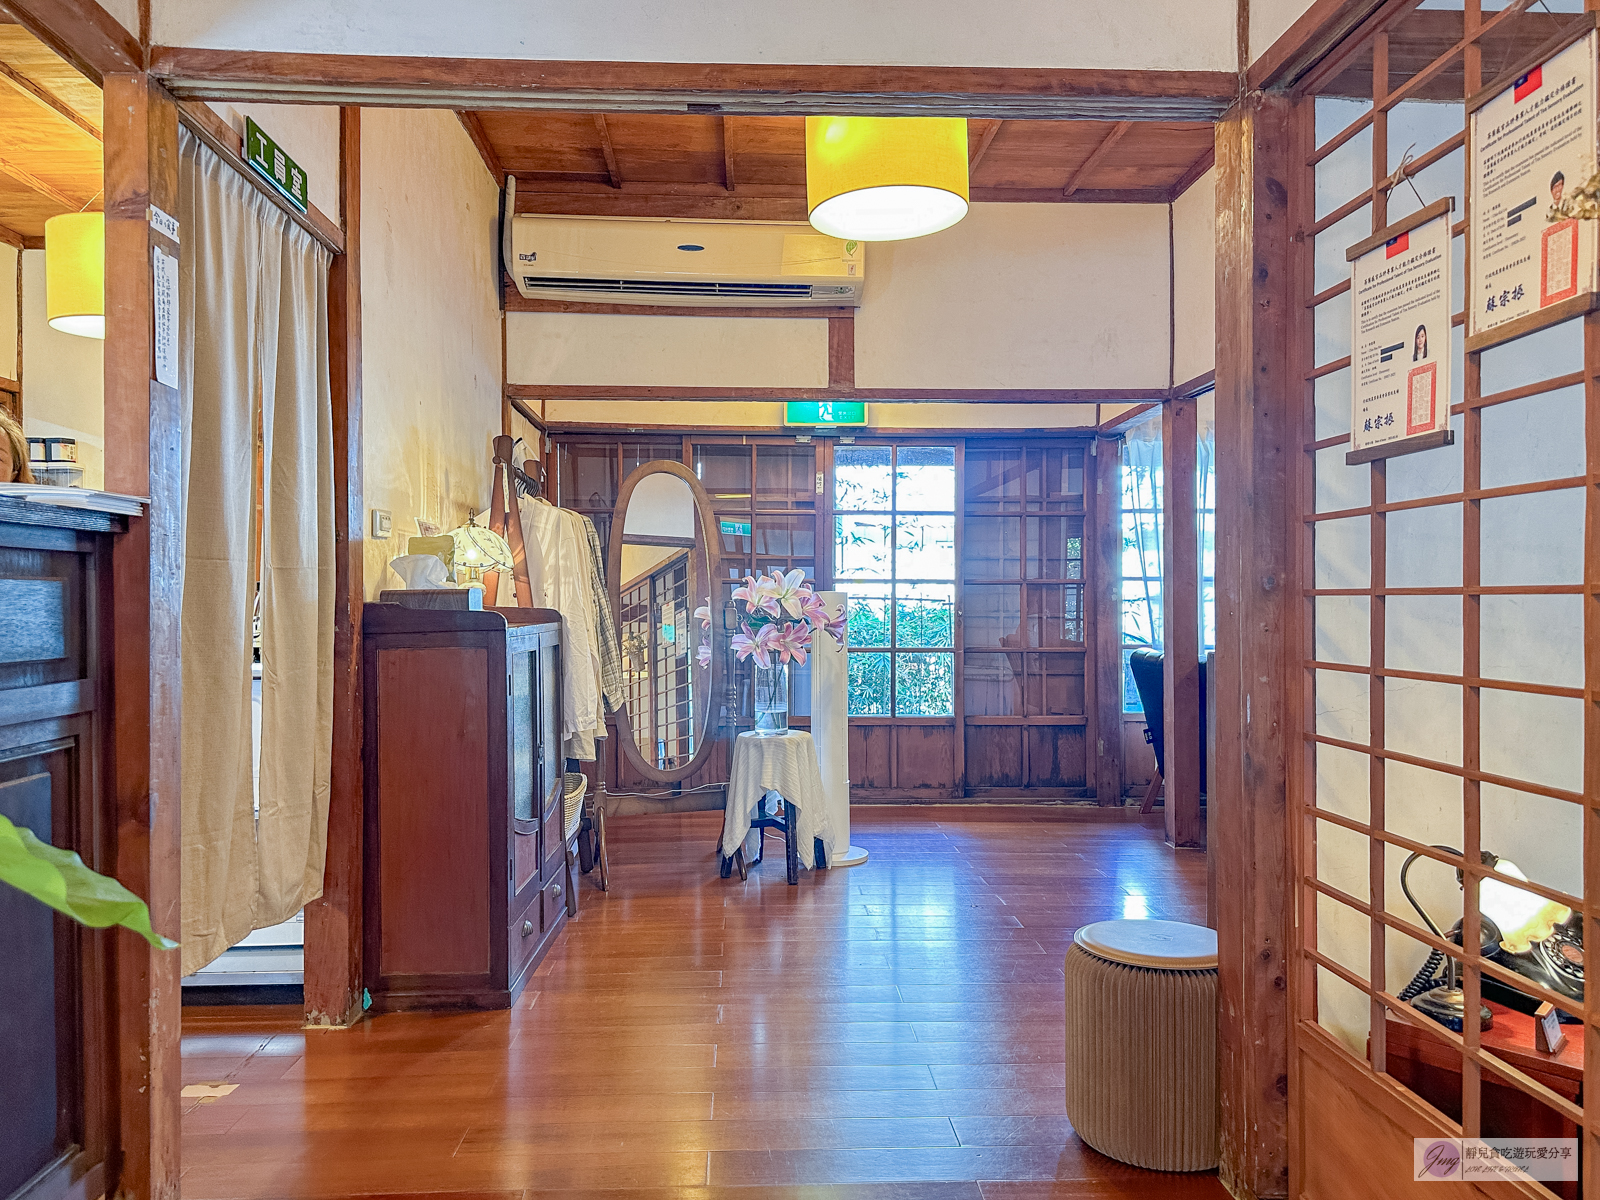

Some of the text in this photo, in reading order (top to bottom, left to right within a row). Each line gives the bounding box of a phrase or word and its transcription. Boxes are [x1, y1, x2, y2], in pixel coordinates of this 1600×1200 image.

[256, 132, 302, 201] 工員室
[1485, 283, 1524, 313] 蘇宗振
[1363, 412, 1394, 432] 蘇宗振
